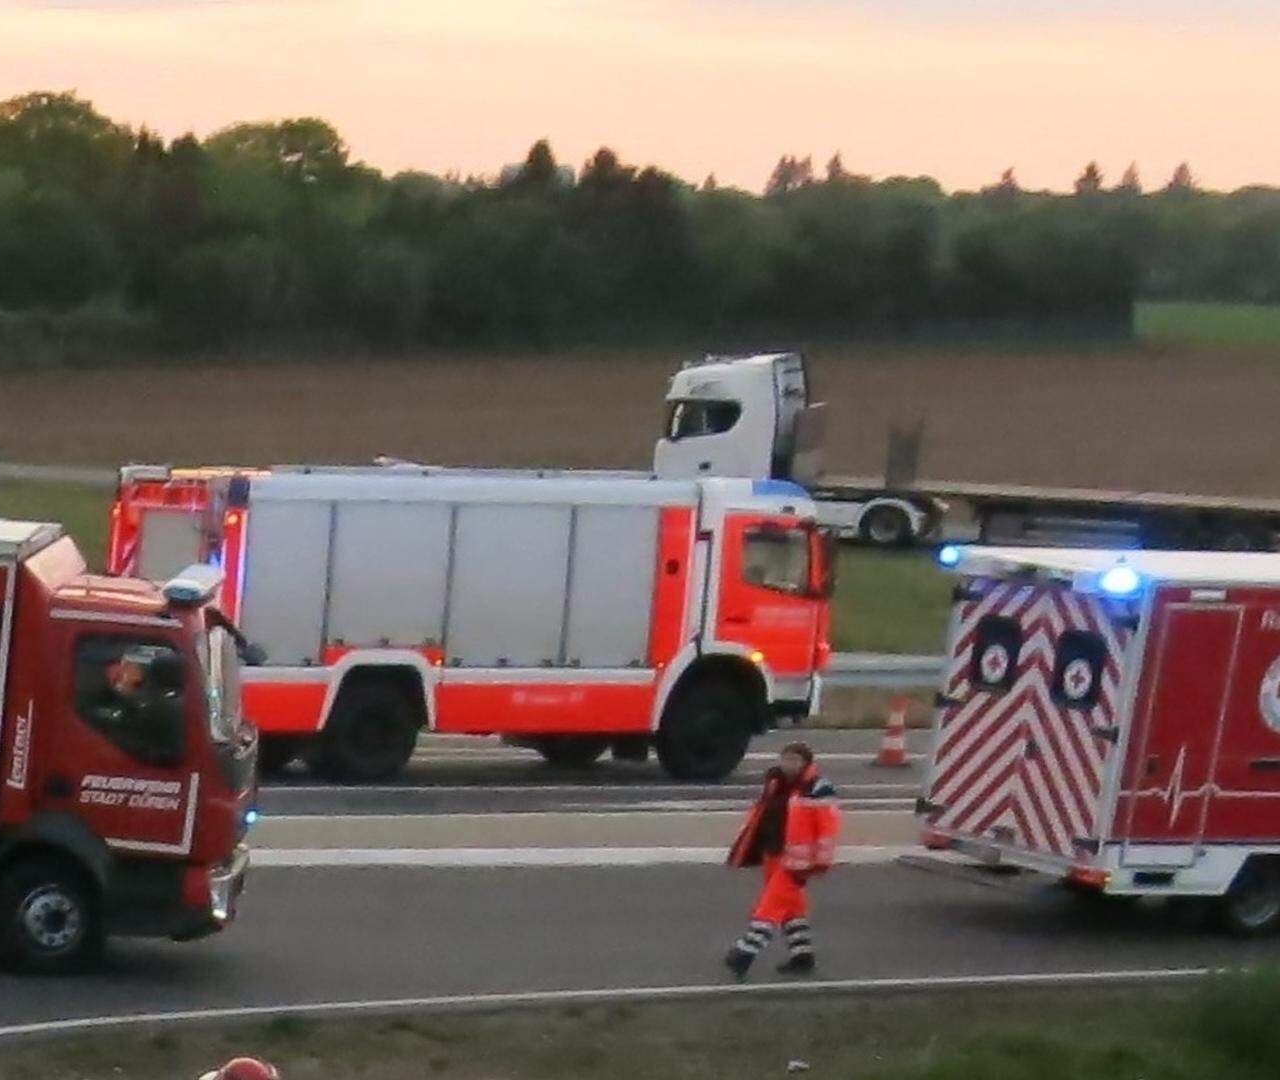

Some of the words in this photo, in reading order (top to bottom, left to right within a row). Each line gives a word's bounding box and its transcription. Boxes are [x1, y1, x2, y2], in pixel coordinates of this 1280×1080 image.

[80, 774, 182, 794] FEUERWEHR
[79, 789, 128, 806] STADT
[128, 791, 182, 811] DÜREN
